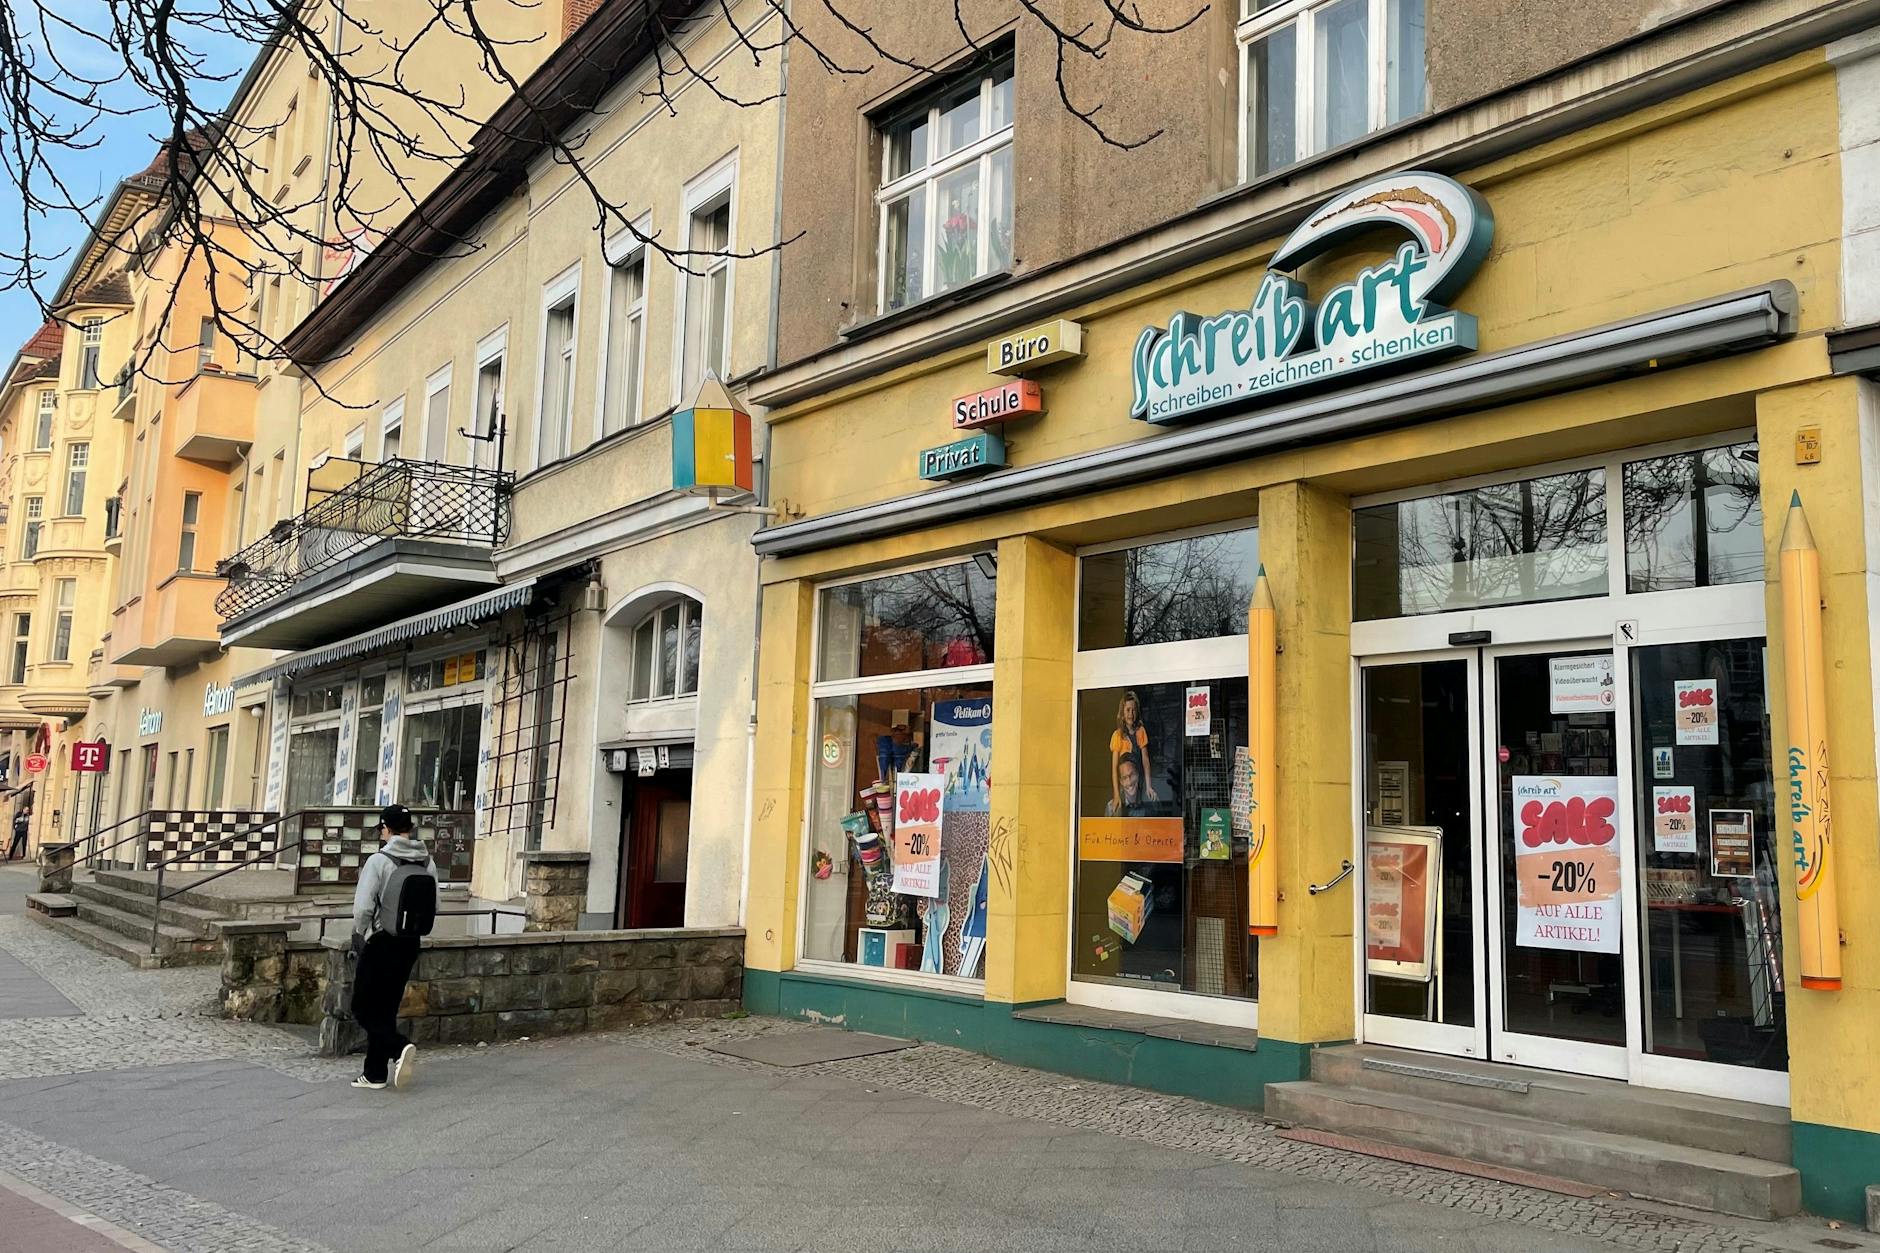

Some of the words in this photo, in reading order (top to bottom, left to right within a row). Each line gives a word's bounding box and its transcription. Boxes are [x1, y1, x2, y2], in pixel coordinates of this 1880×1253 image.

[1322, 249, 1428, 346] art
[1000, 334, 1050, 366] Büro
[1152, 382, 1233, 416] schreiben
[1249, 357, 1333, 391] zeichnen
[1351, 325, 1453, 365] schenken
[955, 387, 1020, 424] Schule
[924, 441, 981, 475] Privat
[953, 705, 982, 719] Pelikan
[1678, 688, 1714, 708] SALE
[80, 747, 99, 767] T
[899, 788, 941, 824] SALE
[1657, 795, 1692, 814] SALE
[1520, 796, 1616, 848] SALE
[904, 832, 930, 857] -20%
[1537, 860, 1596, 894] -20%
[1535, 903, 1562, 918] AUF
[1564, 905, 1603, 920] ALLE
[1533, 924, 1601, 942] ARTIKEL!
